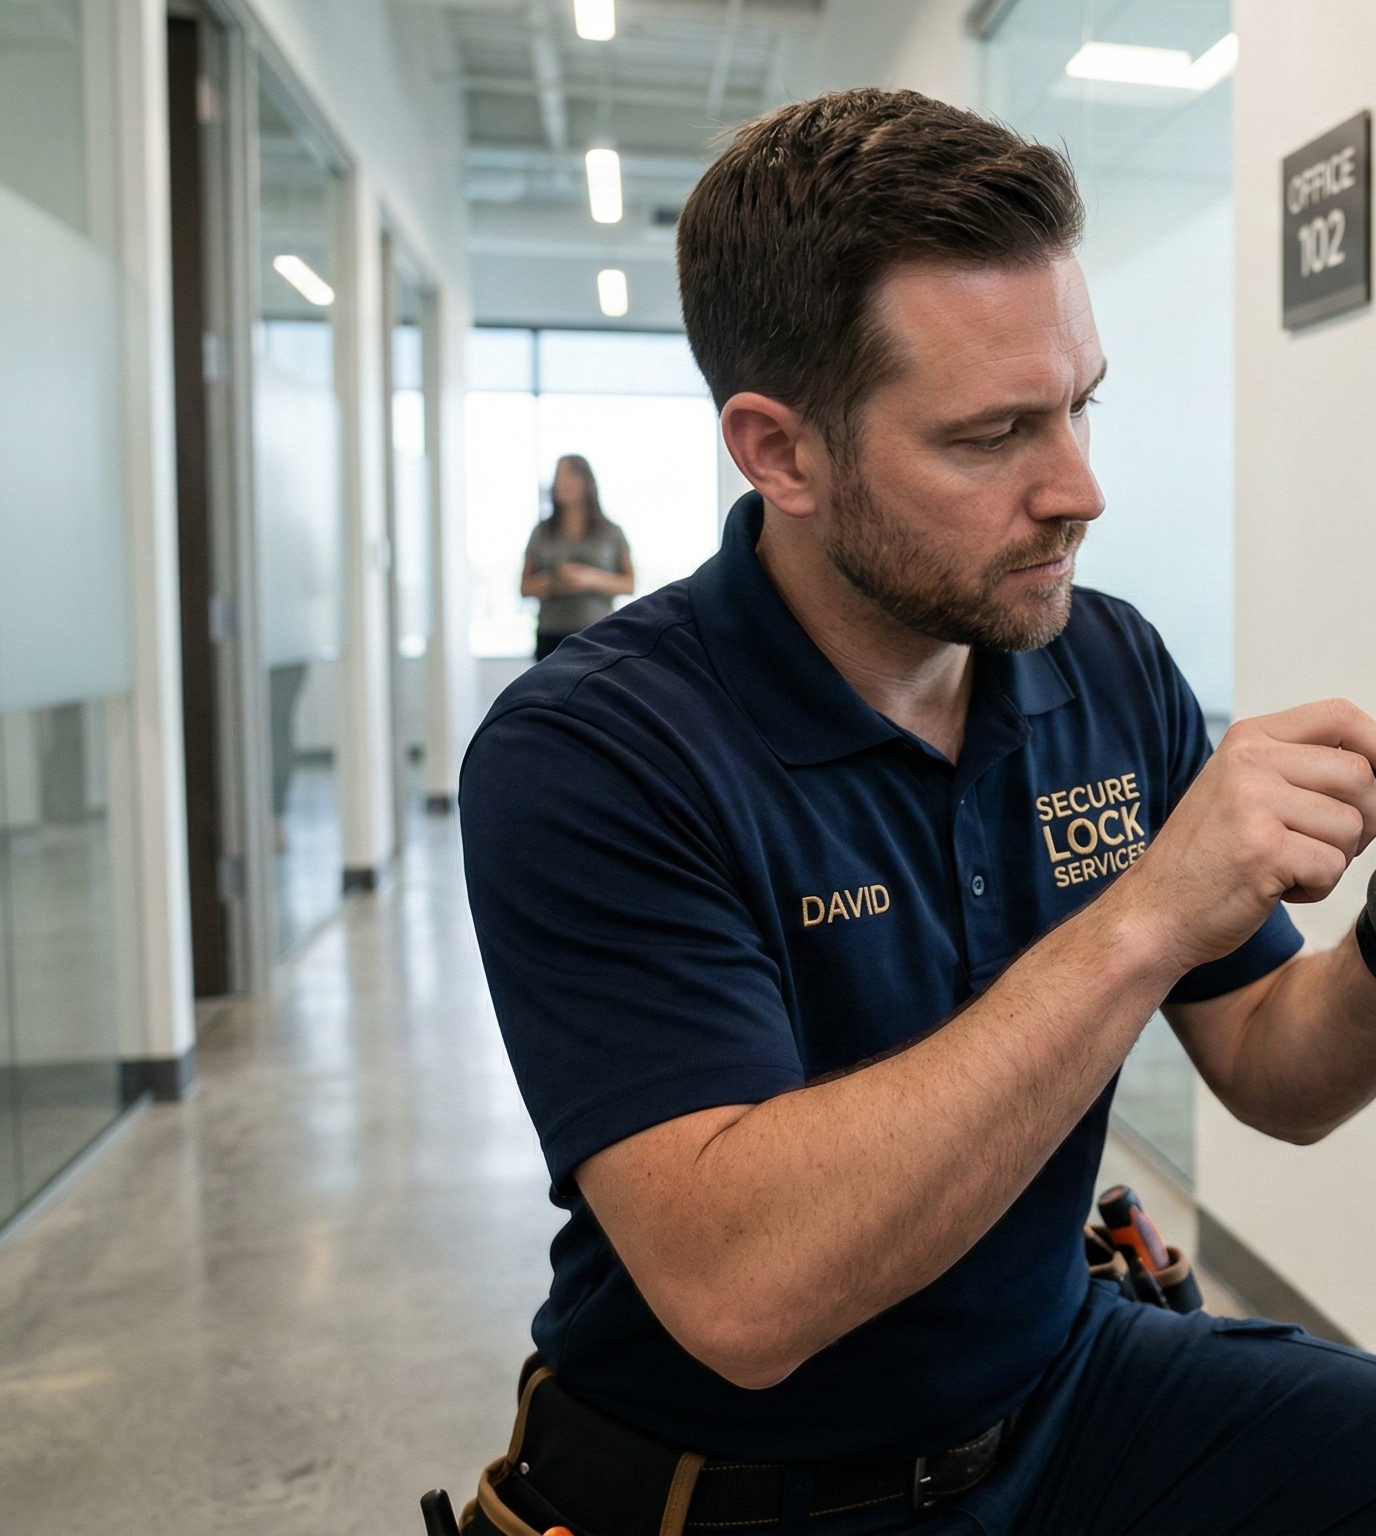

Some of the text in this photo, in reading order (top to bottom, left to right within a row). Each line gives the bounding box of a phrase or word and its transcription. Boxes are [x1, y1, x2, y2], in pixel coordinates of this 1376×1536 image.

[1287, 147, 1356, 215] OFFICE
[1298, 208, 1346, 278] 102
[1036, 773, 1141, 821] SECURE
[1042, 801, 1146, 863] LOCK
[1054, 841, 1146, 888] SERVICES
[801, 884, 891, 927] DAVID
